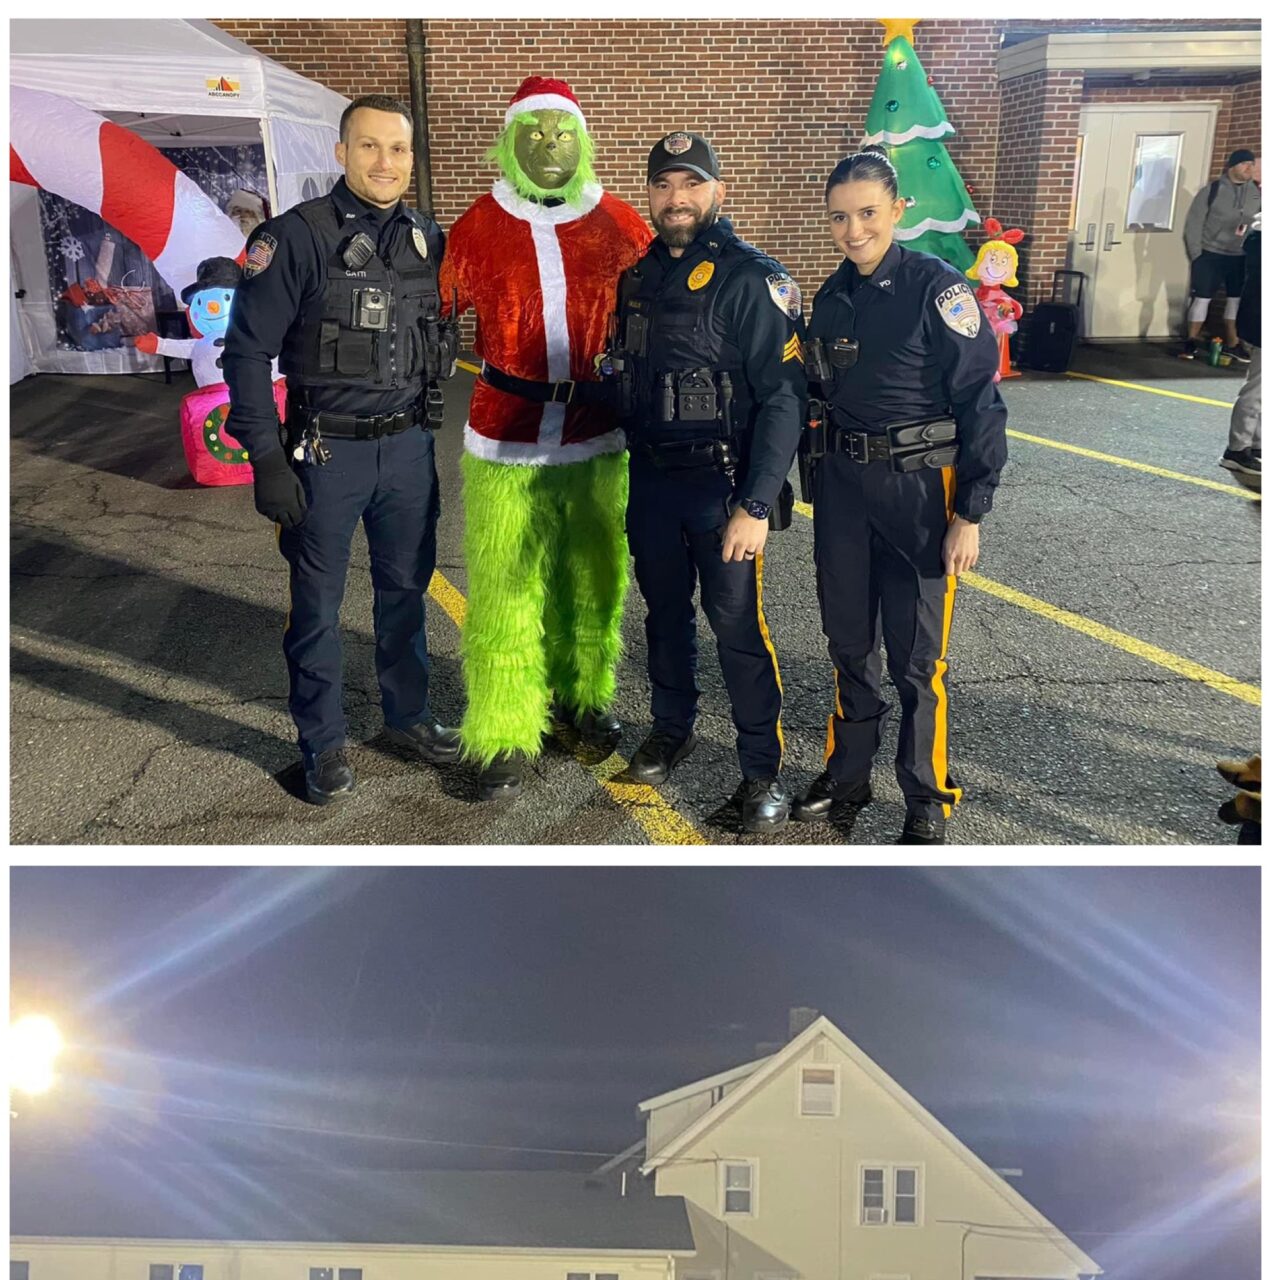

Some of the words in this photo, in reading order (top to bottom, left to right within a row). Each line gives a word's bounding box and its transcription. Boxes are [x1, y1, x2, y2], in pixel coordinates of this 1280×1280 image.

[345, 270, 367, 278] GATTI
[879, 280, 891, 288] PD
[966, 323, 978, 337] NJ
